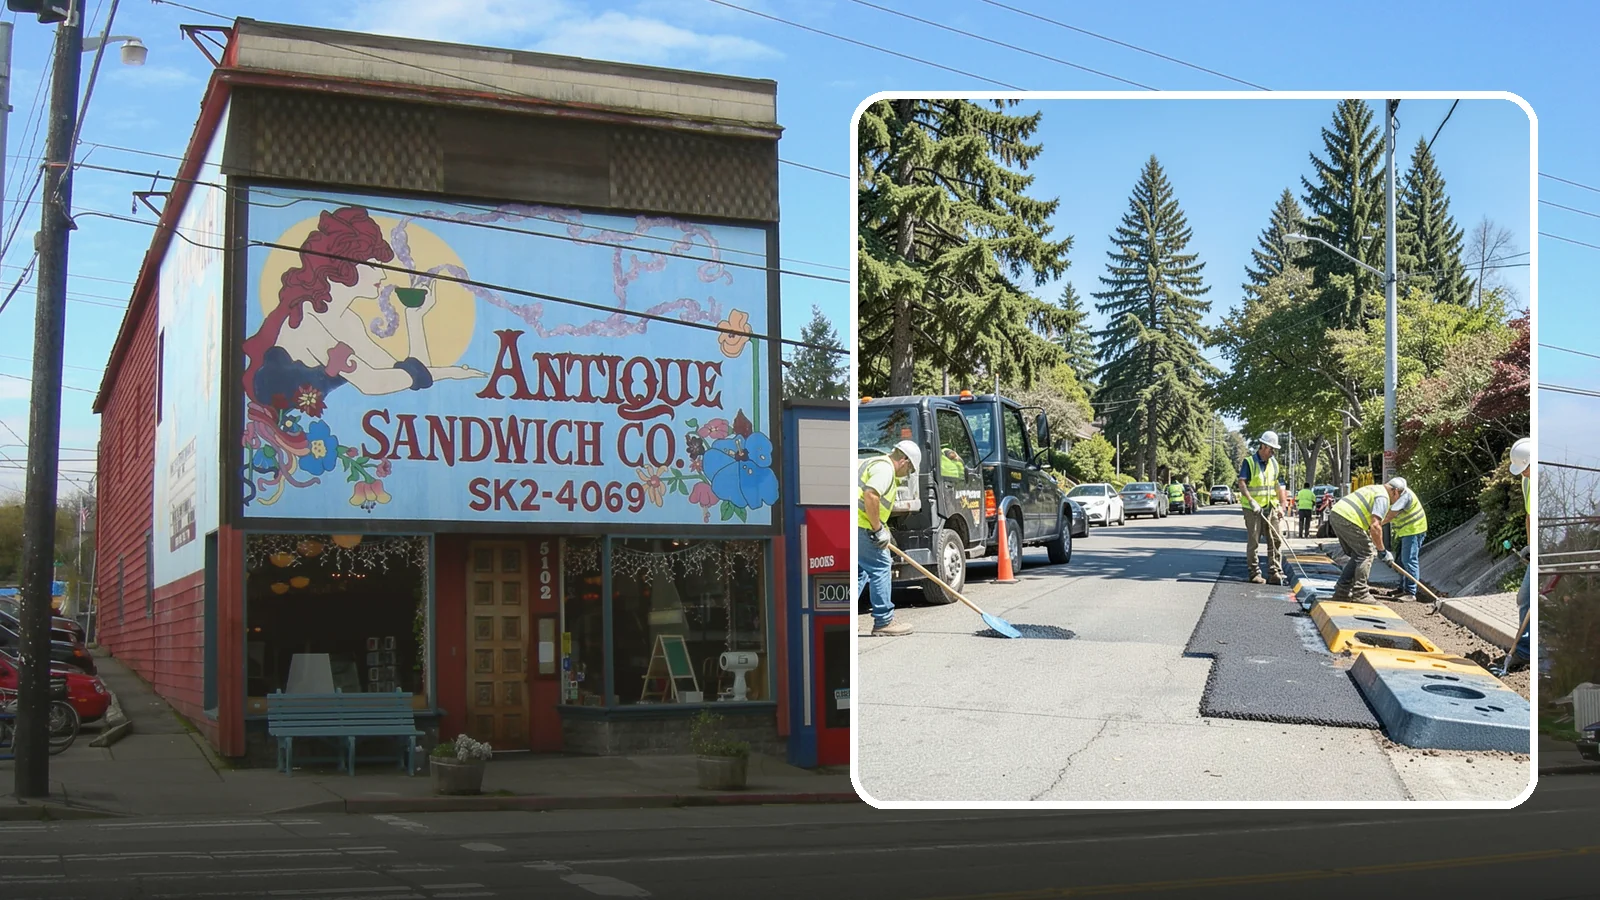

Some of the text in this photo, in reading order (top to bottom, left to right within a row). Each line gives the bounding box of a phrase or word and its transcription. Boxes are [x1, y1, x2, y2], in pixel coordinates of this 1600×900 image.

[476, 329, 723, 421] ANTIQUE
[361, 409, 684, 468] SANDWICH CO.
[468, 477, 644, 512] SK2-4069
[540, 542, 551, 599] 5102
[809, 555, 835, 569] BOOKS
